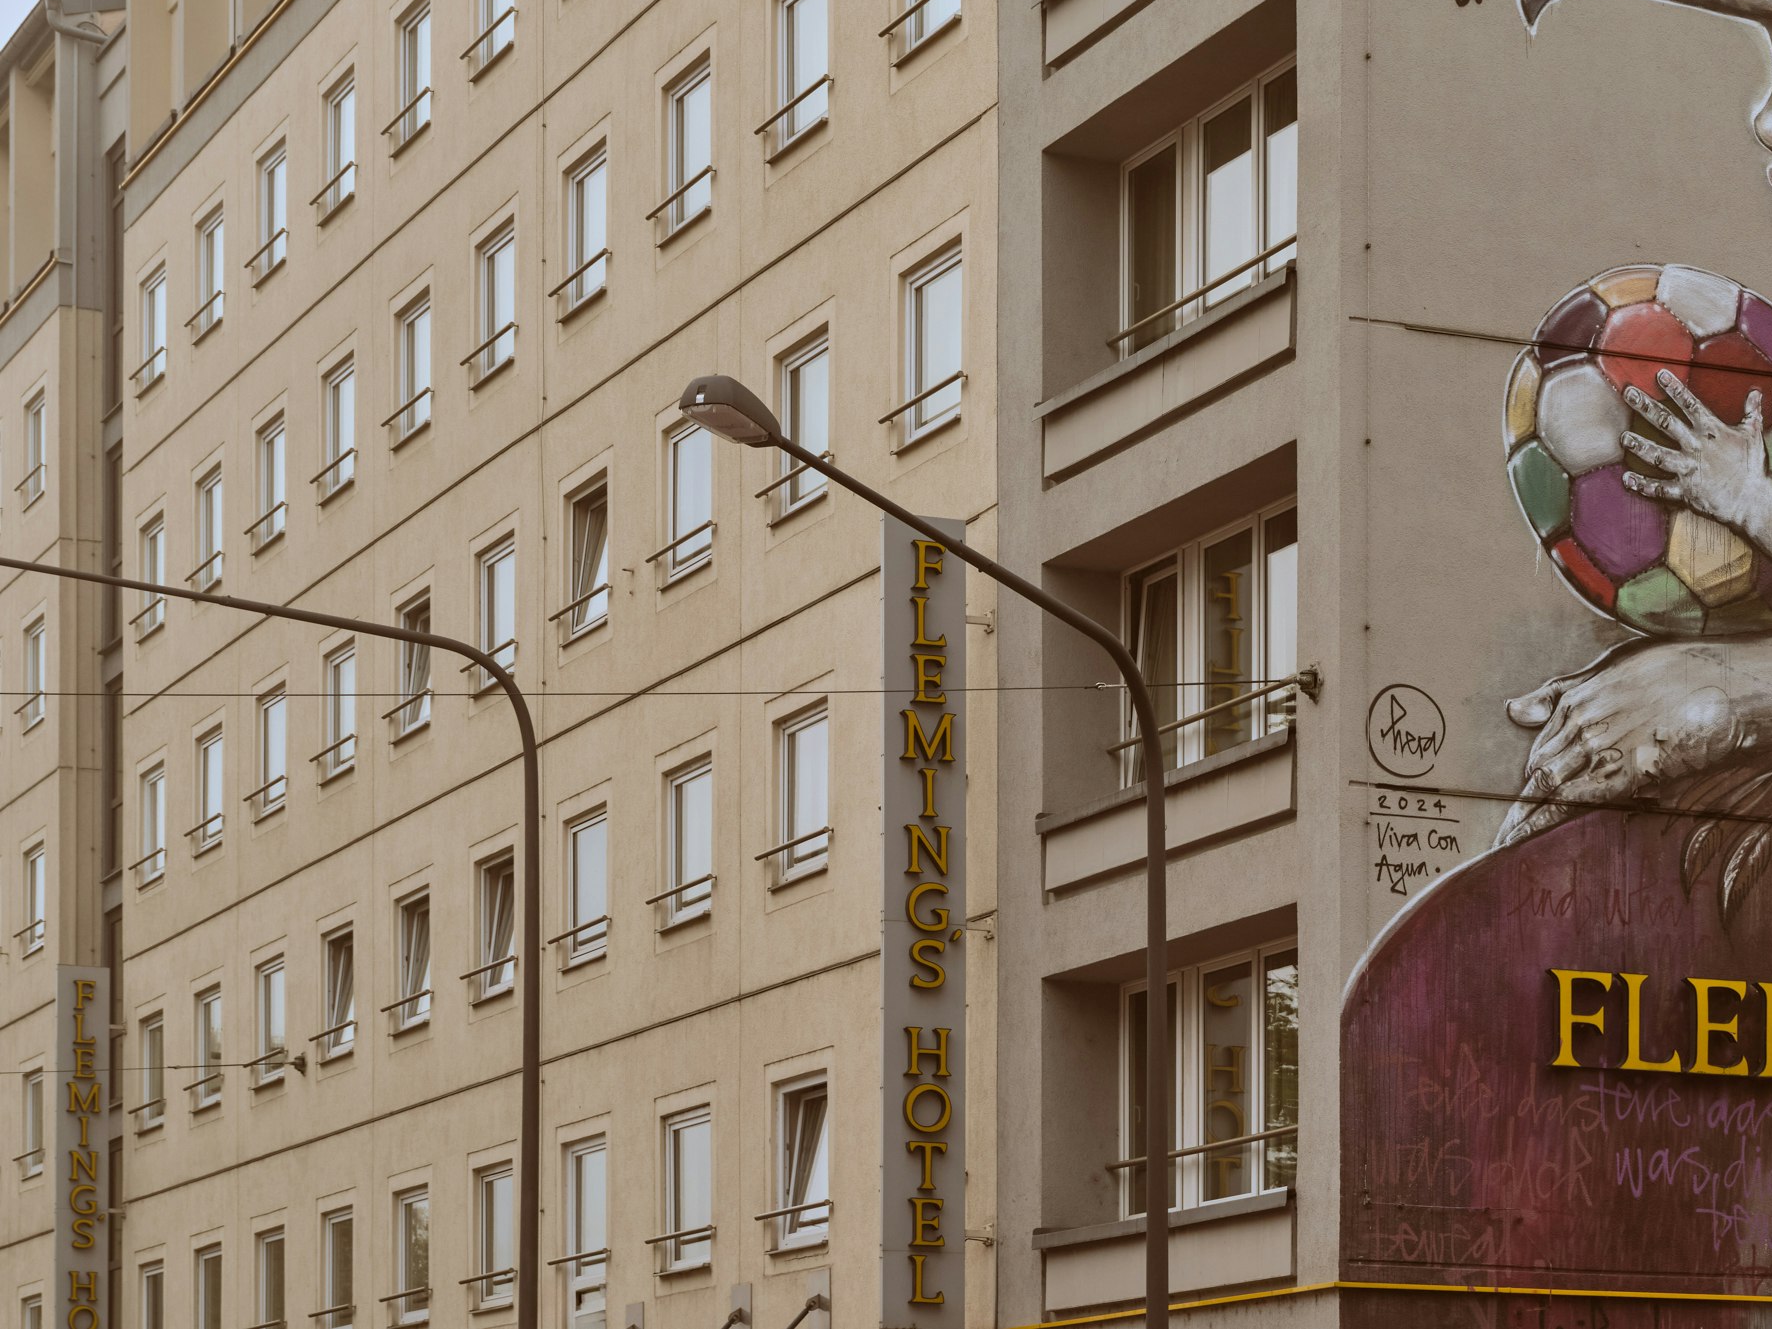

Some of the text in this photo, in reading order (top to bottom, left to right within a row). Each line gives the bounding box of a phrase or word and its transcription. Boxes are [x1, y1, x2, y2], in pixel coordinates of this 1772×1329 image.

[1378, 794, 1447, 814] 2024
[1376, 822, 1460, 853] Viva Con
[899, 539, 963, 1305] FLEMING'S HOTEL
[1507, 858, 1592, 950] find
